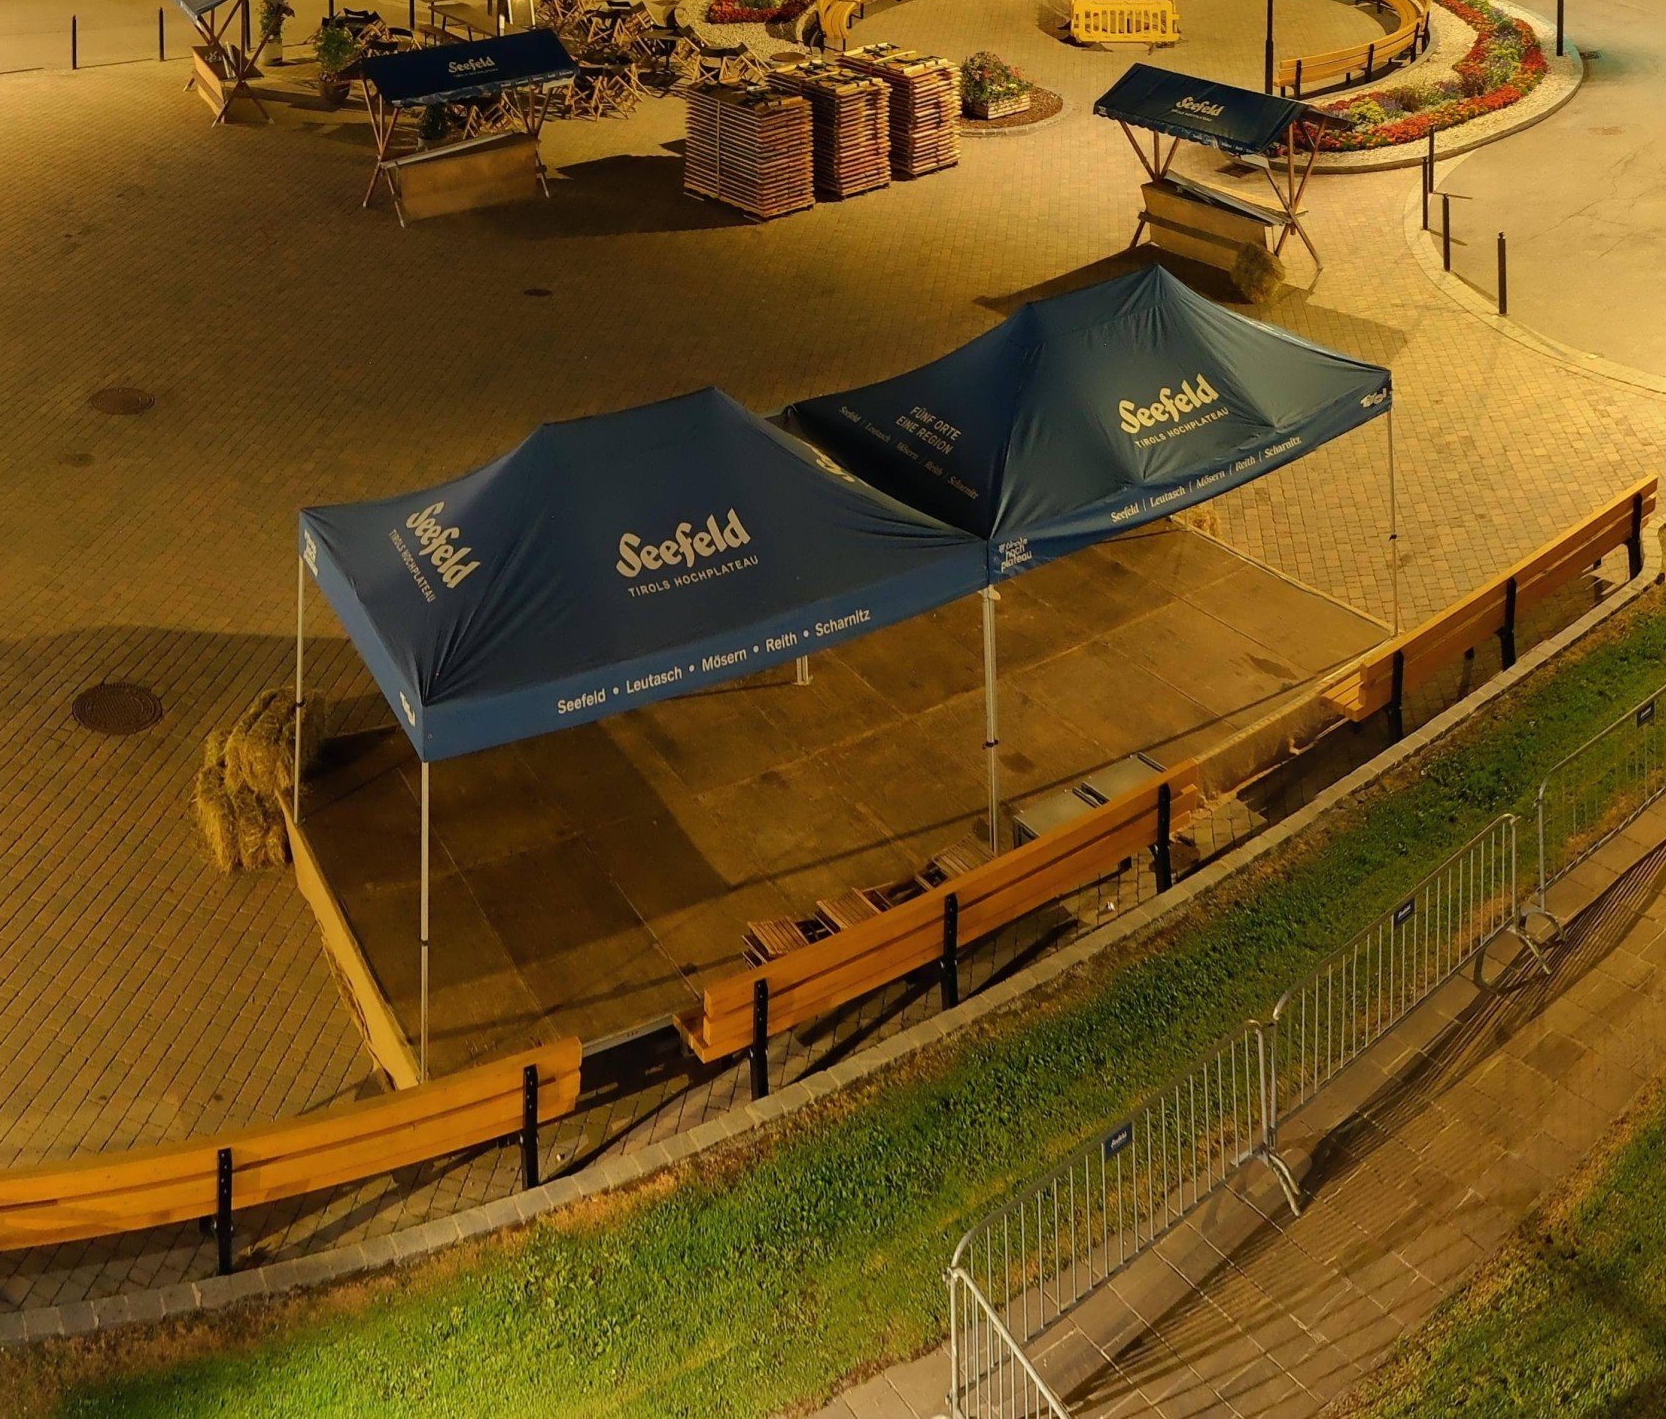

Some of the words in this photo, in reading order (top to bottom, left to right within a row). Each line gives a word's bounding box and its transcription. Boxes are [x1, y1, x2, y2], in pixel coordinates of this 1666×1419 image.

[448, 56, 495, 74] Seefeld
[1176, 96, 1225, 117] Seefeld
[910, 406, 936, 424] FÜNF
[934, 420, 972, 441] ORTE
[1119, 373, 1220, 434] Seefeld
[1135, 432, 1167, 449] TIROLS
[1167, 407, 1230, 439] HOCHPLATEAU
[895, 416, 920, 434] EINE
[915, 428, 954, 455] REGION
[1110, 504, 1140, 524] Seefeld
[1149, 486, 1186, 508] Leutasch
[1195, 470, 1226, 490] Mösern
[1235, 455, 1257, 473] Reith
[1264, 436, 1302, 459] Scharnitz
[389, 528, 407, 553] TIROLS
[401, 548, 437, 604] HOCHPLATEAU
[406, 501, 482, 590] Seefeld
[615, 507, 751, 578] Seefeld
[628, 580, 671, 597] TIROLS
[673, 555, 759, 587] HOCHPLATEAU
[556, 688, 607, 714] Seefeld
[625, 666, 683, 694] Leutasch
[701, 647, 748, 672] Mösern
[765, 632, 798, 653] Reith
[814, 608, 871, 638] Scharnitz
